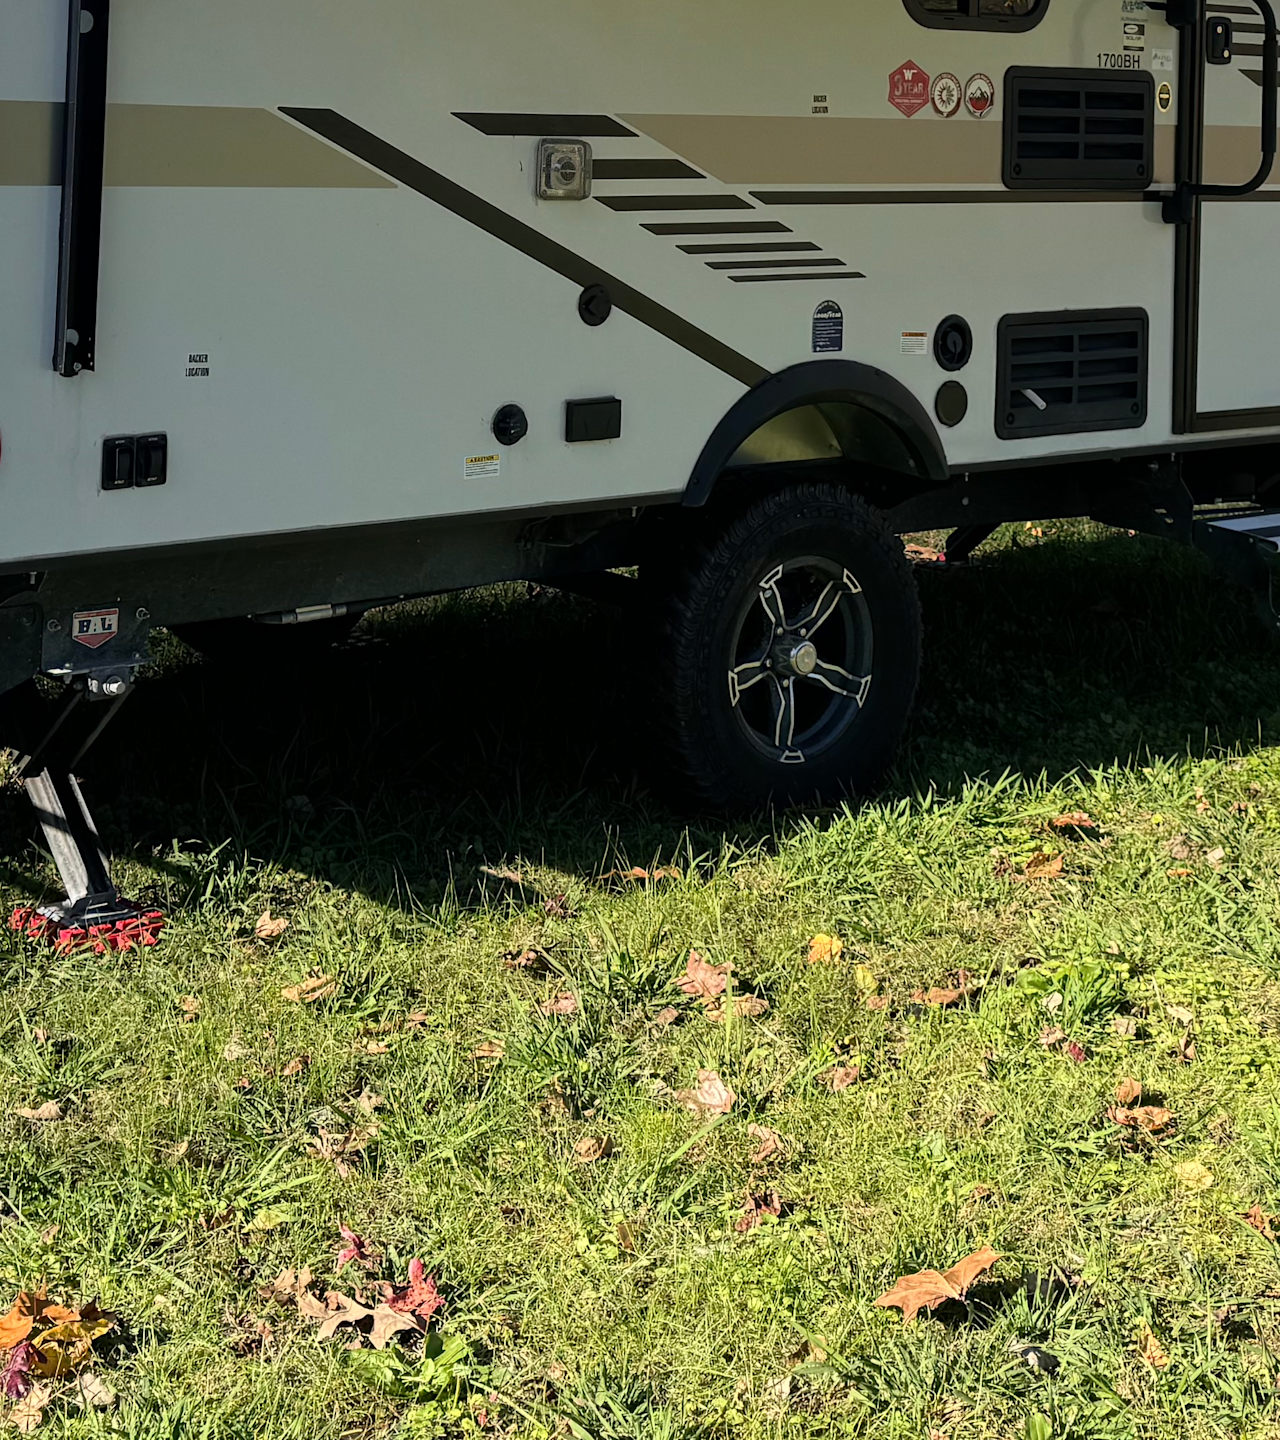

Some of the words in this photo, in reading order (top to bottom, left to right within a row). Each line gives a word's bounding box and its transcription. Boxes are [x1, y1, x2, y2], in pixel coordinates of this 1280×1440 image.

[1096, 53, 1141, 69] 1700BH
[894, 74, 903, 96] 3
[903, 82, 924, 96] YEAR
